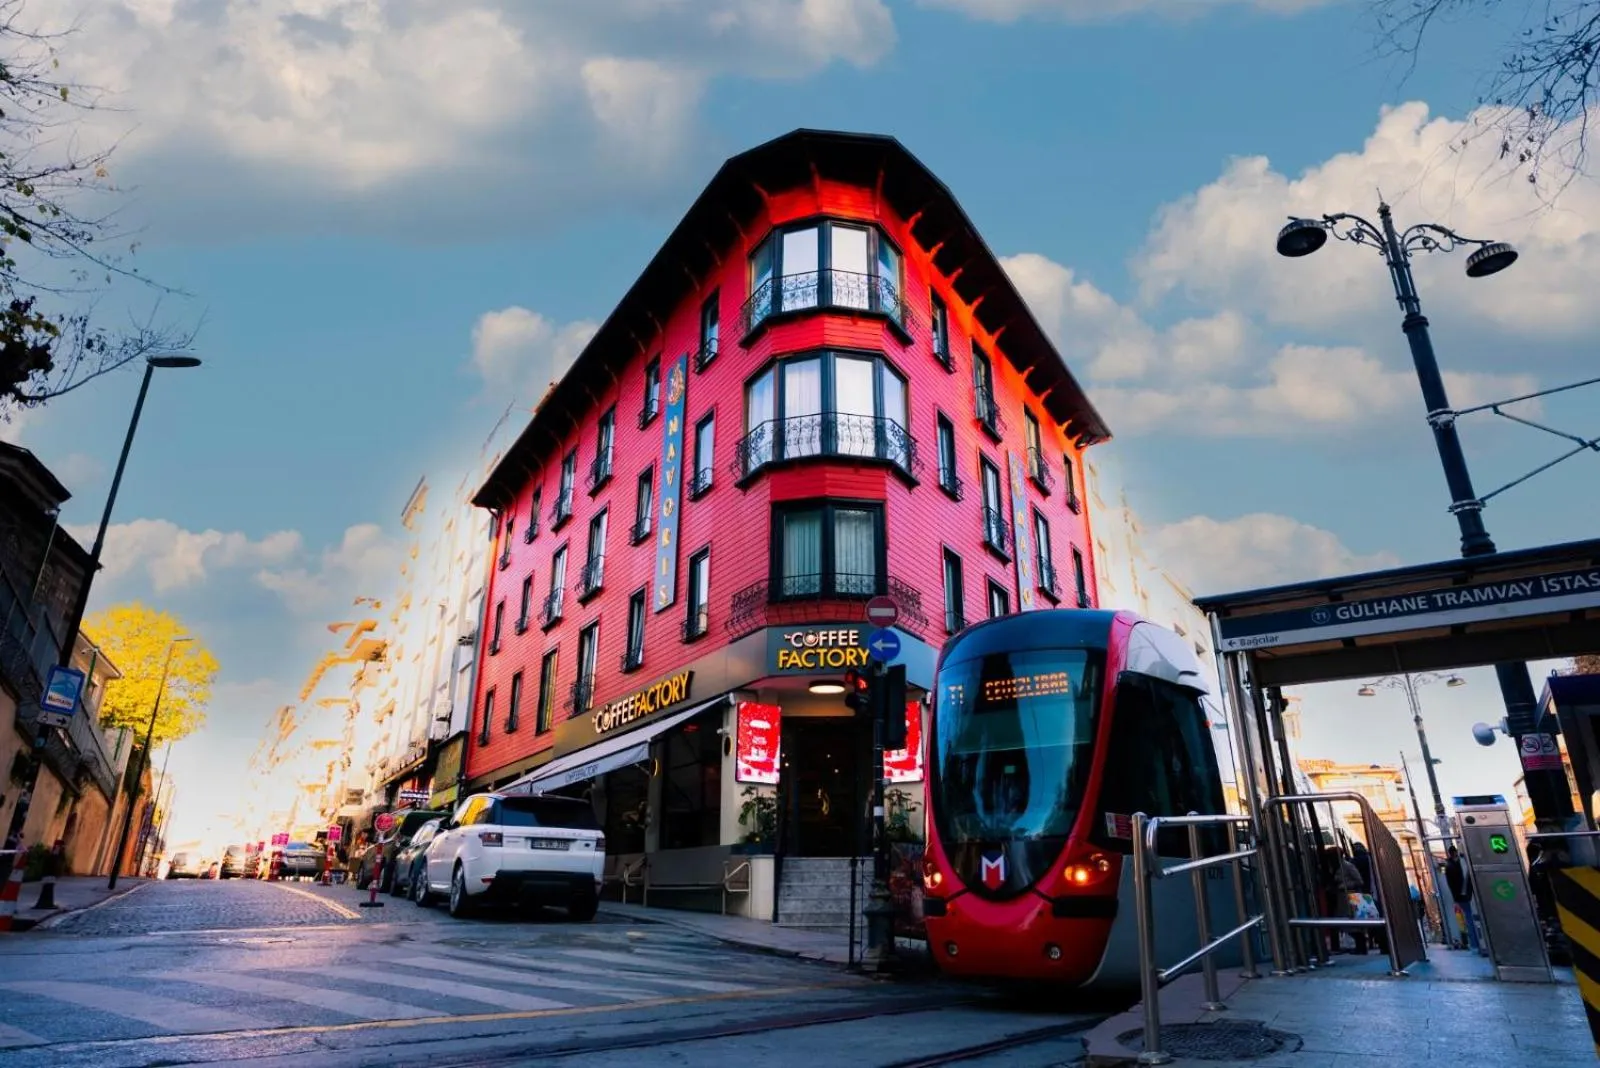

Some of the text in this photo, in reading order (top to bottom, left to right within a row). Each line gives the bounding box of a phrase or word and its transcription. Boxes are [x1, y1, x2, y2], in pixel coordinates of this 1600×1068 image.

[1336, 595, 1428, 620] GÜLHANE
[1433, 581, 1534, 608] TRAMVAY
[790, 629, 859, 648] COFFEE
[778, 647, 870, 669] FACTORY
